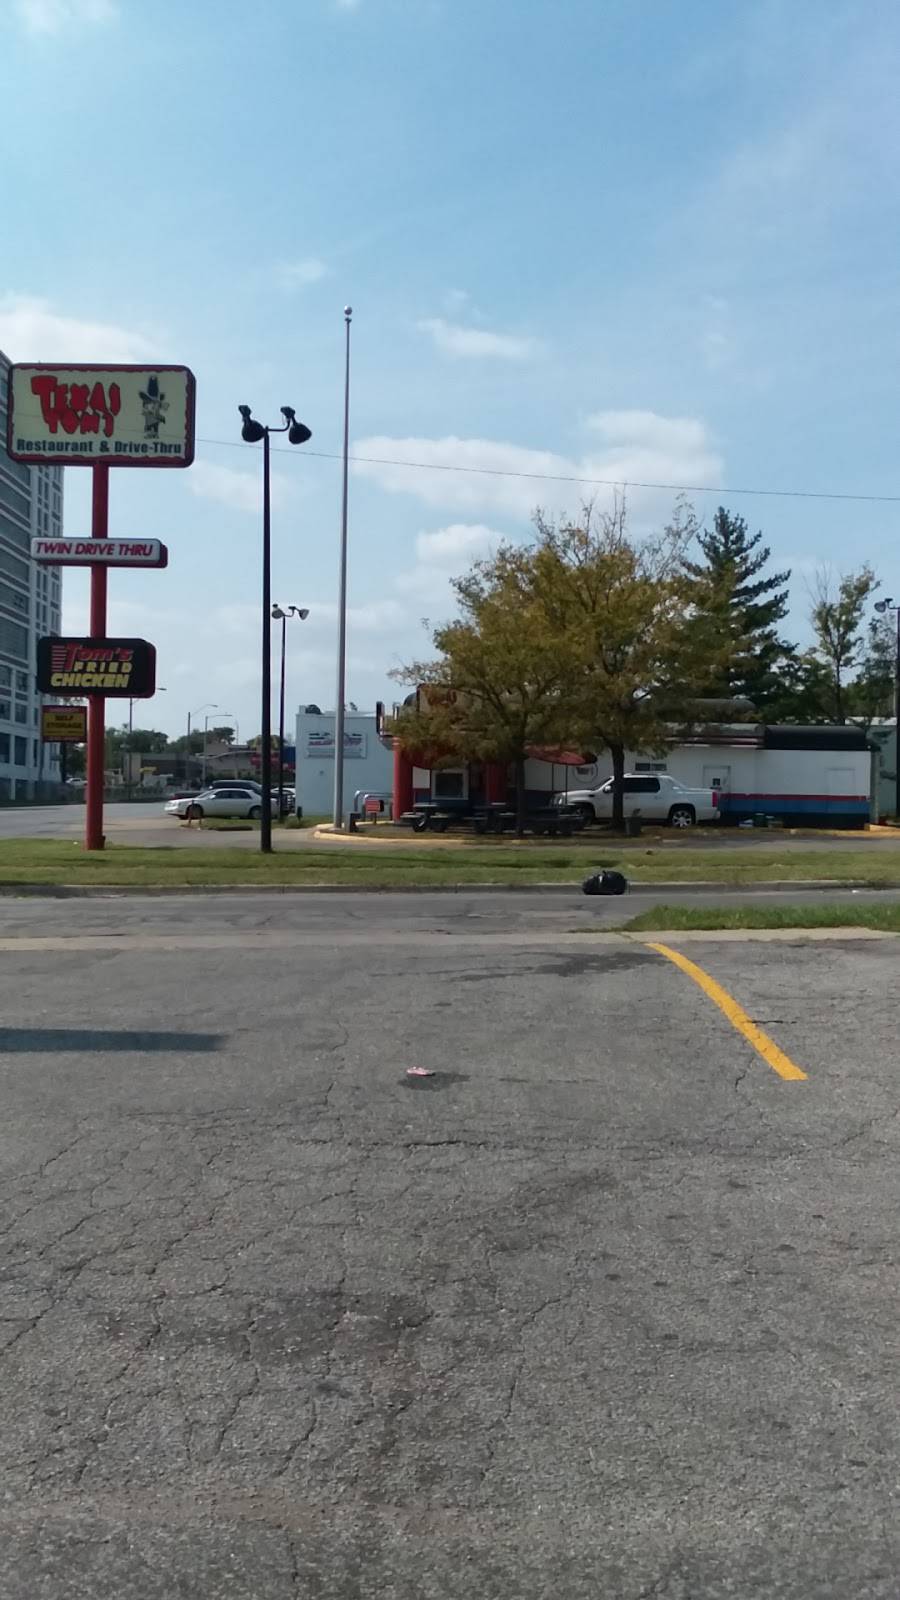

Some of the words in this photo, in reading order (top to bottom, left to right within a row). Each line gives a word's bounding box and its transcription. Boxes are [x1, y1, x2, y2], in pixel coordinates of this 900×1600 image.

[17, 438, 93, 452] Restaurant
[99, 440, 110, 453] &
[114, 441, 182, 454] Drive-Thru
[36, 542, 73, 555] TWIN
[75, 543, 115, 556] DRIVE
[119, 544, 153, 556] THRU
[65, 642, 134, 671] Tom's
[74, 661, 133, 673] FRIED
[50, 673, 130, 688] CHICKEN
